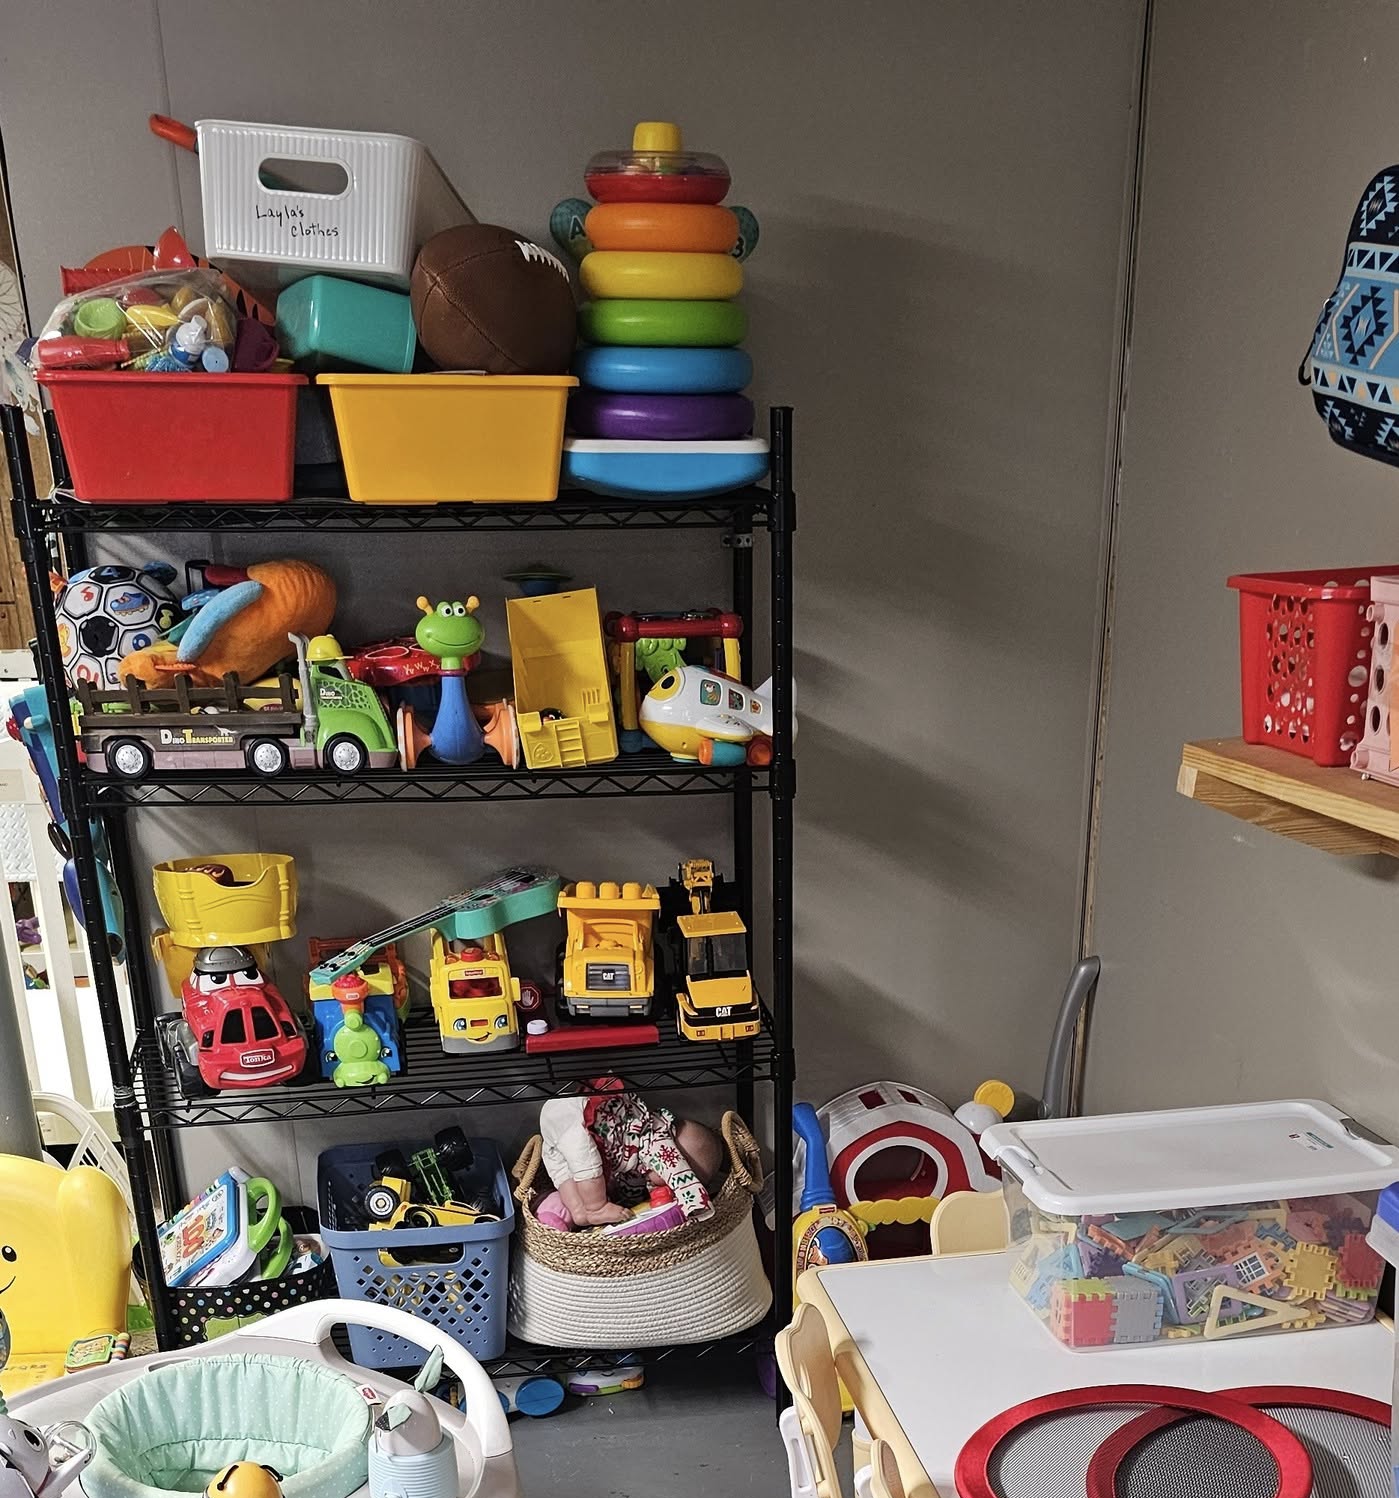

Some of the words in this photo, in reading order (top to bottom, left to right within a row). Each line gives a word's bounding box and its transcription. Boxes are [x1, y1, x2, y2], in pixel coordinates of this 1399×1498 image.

[255, 204, 305, 228] Layla's
[602, 972, 615, 981] CAT
[715, 1006, 733, 1018] CAT
